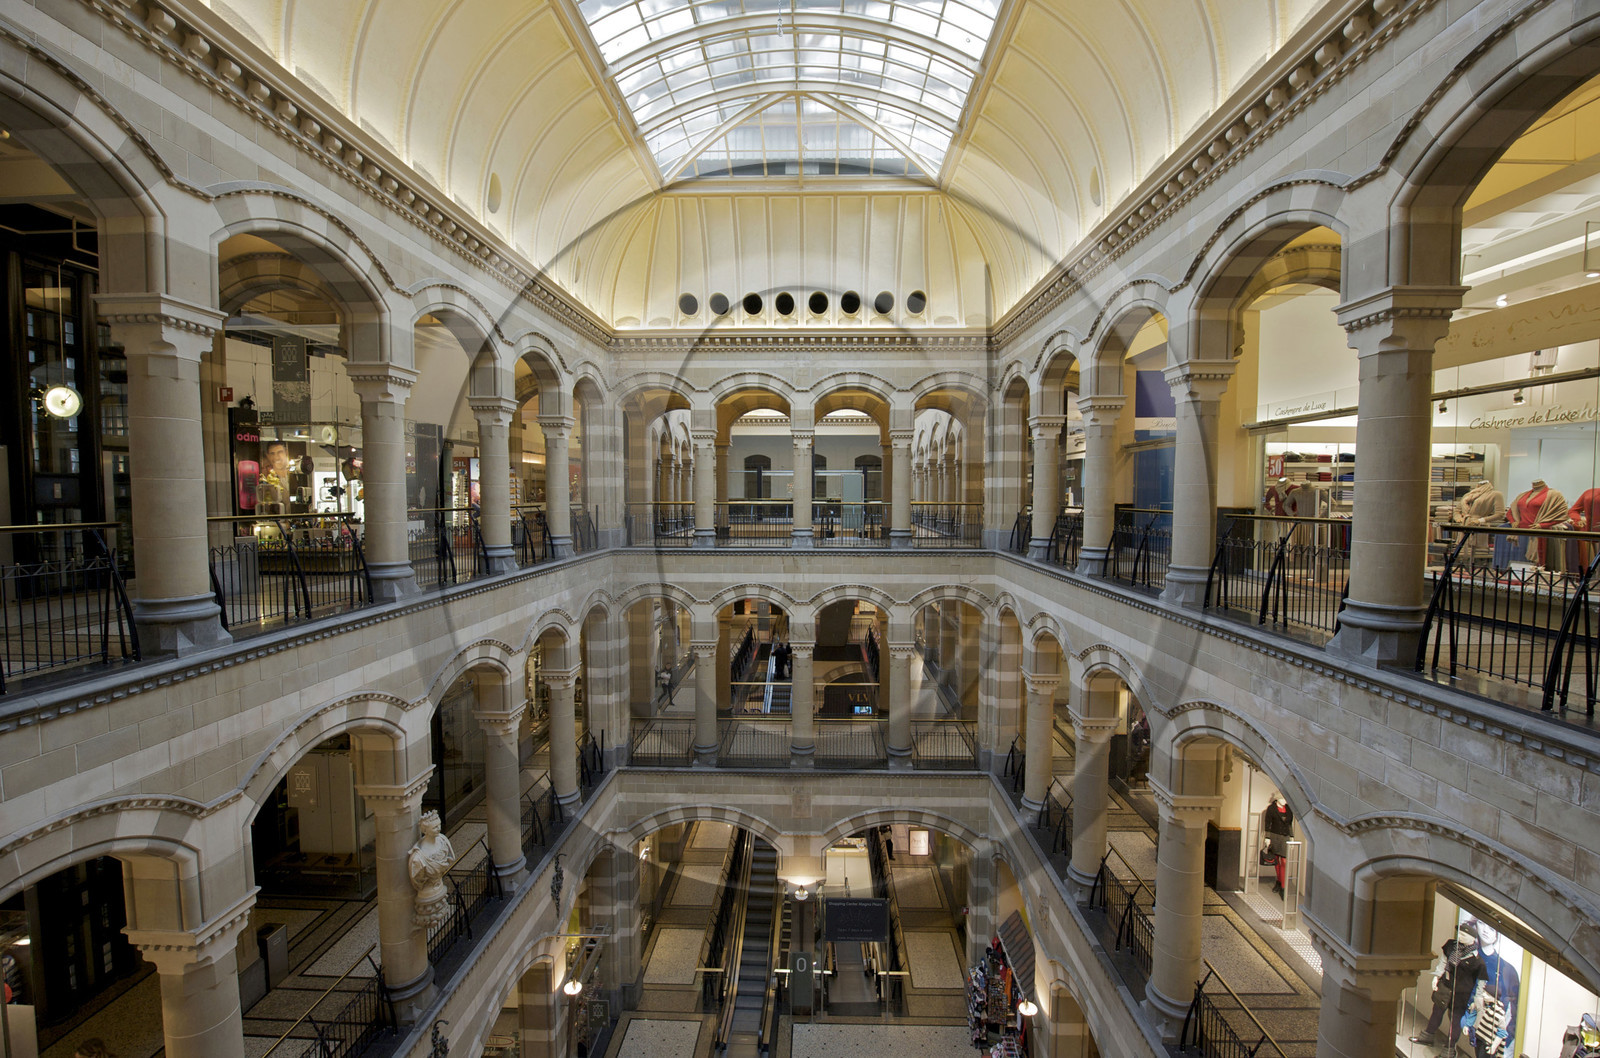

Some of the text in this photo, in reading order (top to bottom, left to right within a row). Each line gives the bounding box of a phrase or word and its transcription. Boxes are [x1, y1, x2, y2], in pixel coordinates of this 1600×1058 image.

[1275, 401, 1327, 417] Cashmere de Luxe
[1470, 415, 1525, 430] Cashmere
[1527, 411, 1543, 425] de
[1545, 408, 1579, 423] Luxe
[236, 432, 259, 443] odm
